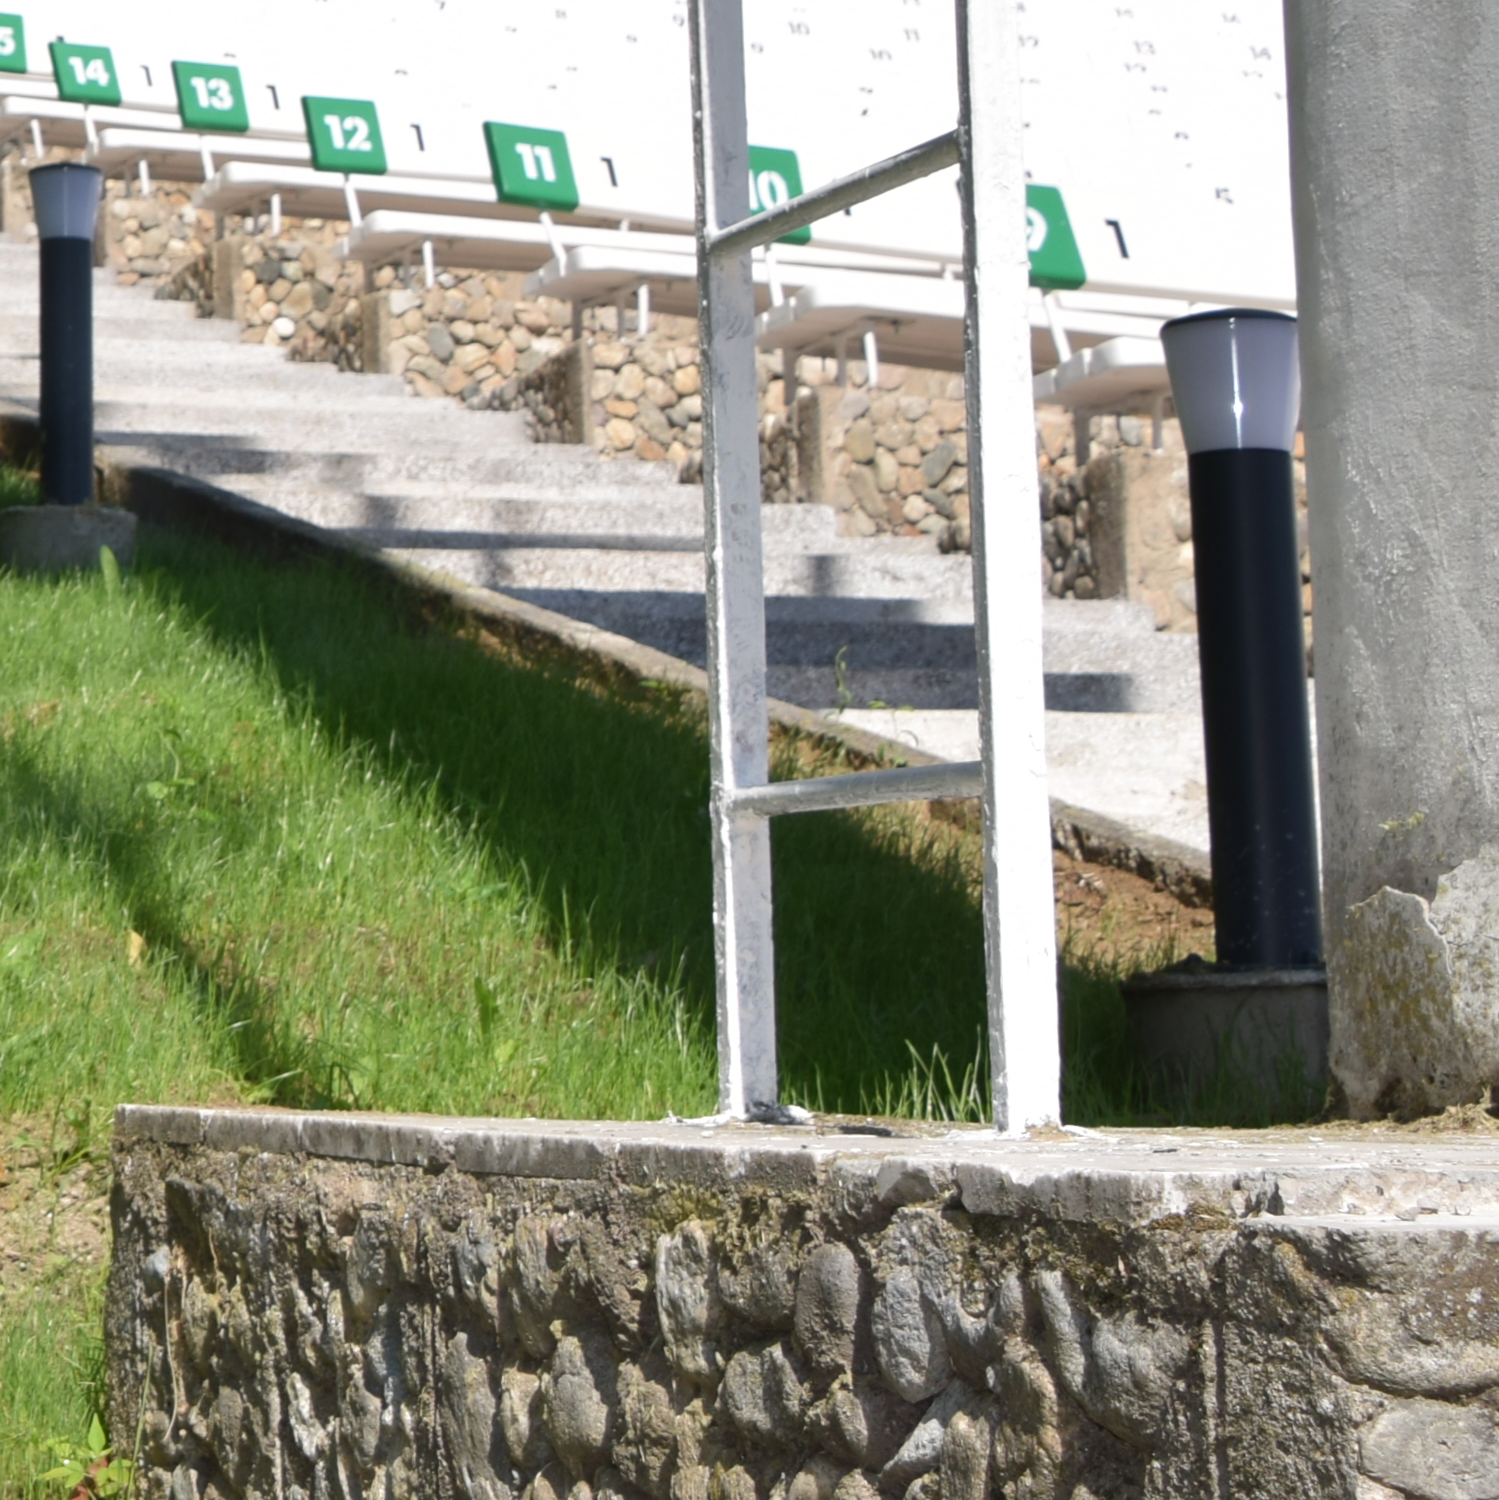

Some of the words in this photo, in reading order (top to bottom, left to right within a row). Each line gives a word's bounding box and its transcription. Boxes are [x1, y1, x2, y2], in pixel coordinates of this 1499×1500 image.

[68, 56, 110, 87] 14
[140, 65, 153, 87] 1
[190, 76, 234, 110] 13
[265, 84, 280, 110] 1
[323, 114, 373, 151] 12
[409, 124, 425, 152] 1
[515, 142, 557, 183] 11
[600, 157, 619, 188] 1
[1104, 217, 1130, 260] 1
